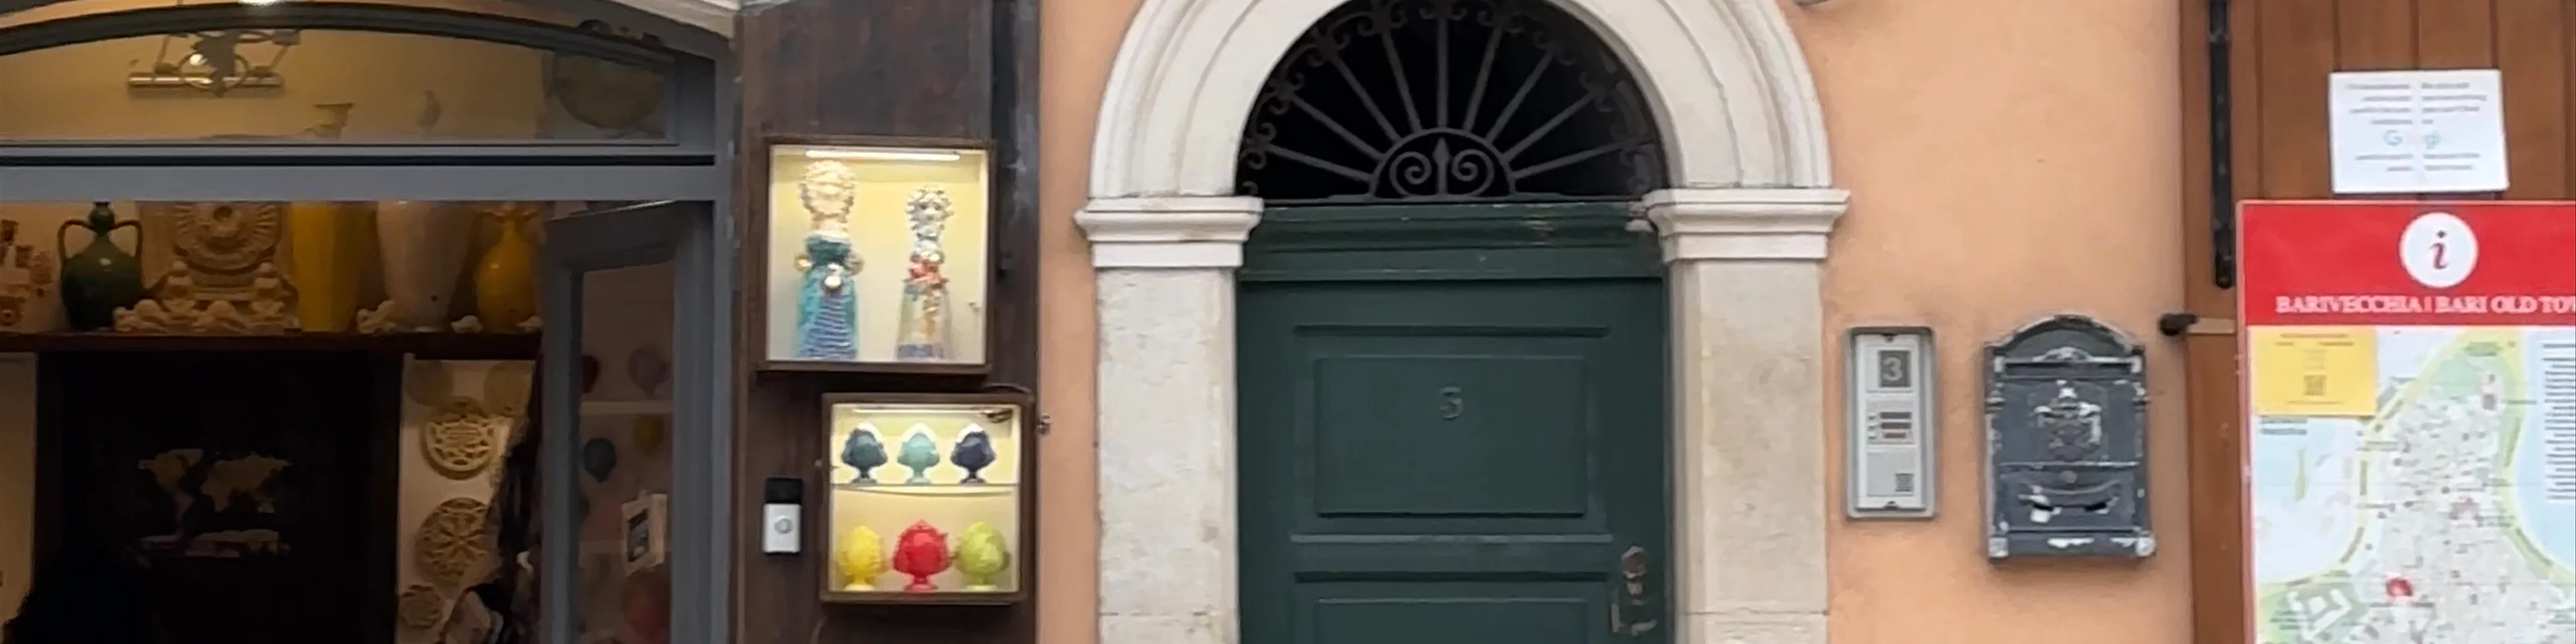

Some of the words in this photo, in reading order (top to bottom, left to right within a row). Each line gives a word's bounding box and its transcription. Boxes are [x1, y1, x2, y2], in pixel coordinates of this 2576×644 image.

[2434, 296, 2488, 313] BARI
[2489, 296, 2538, 313] OLD
[1883, 357, 1903, 381] 3
